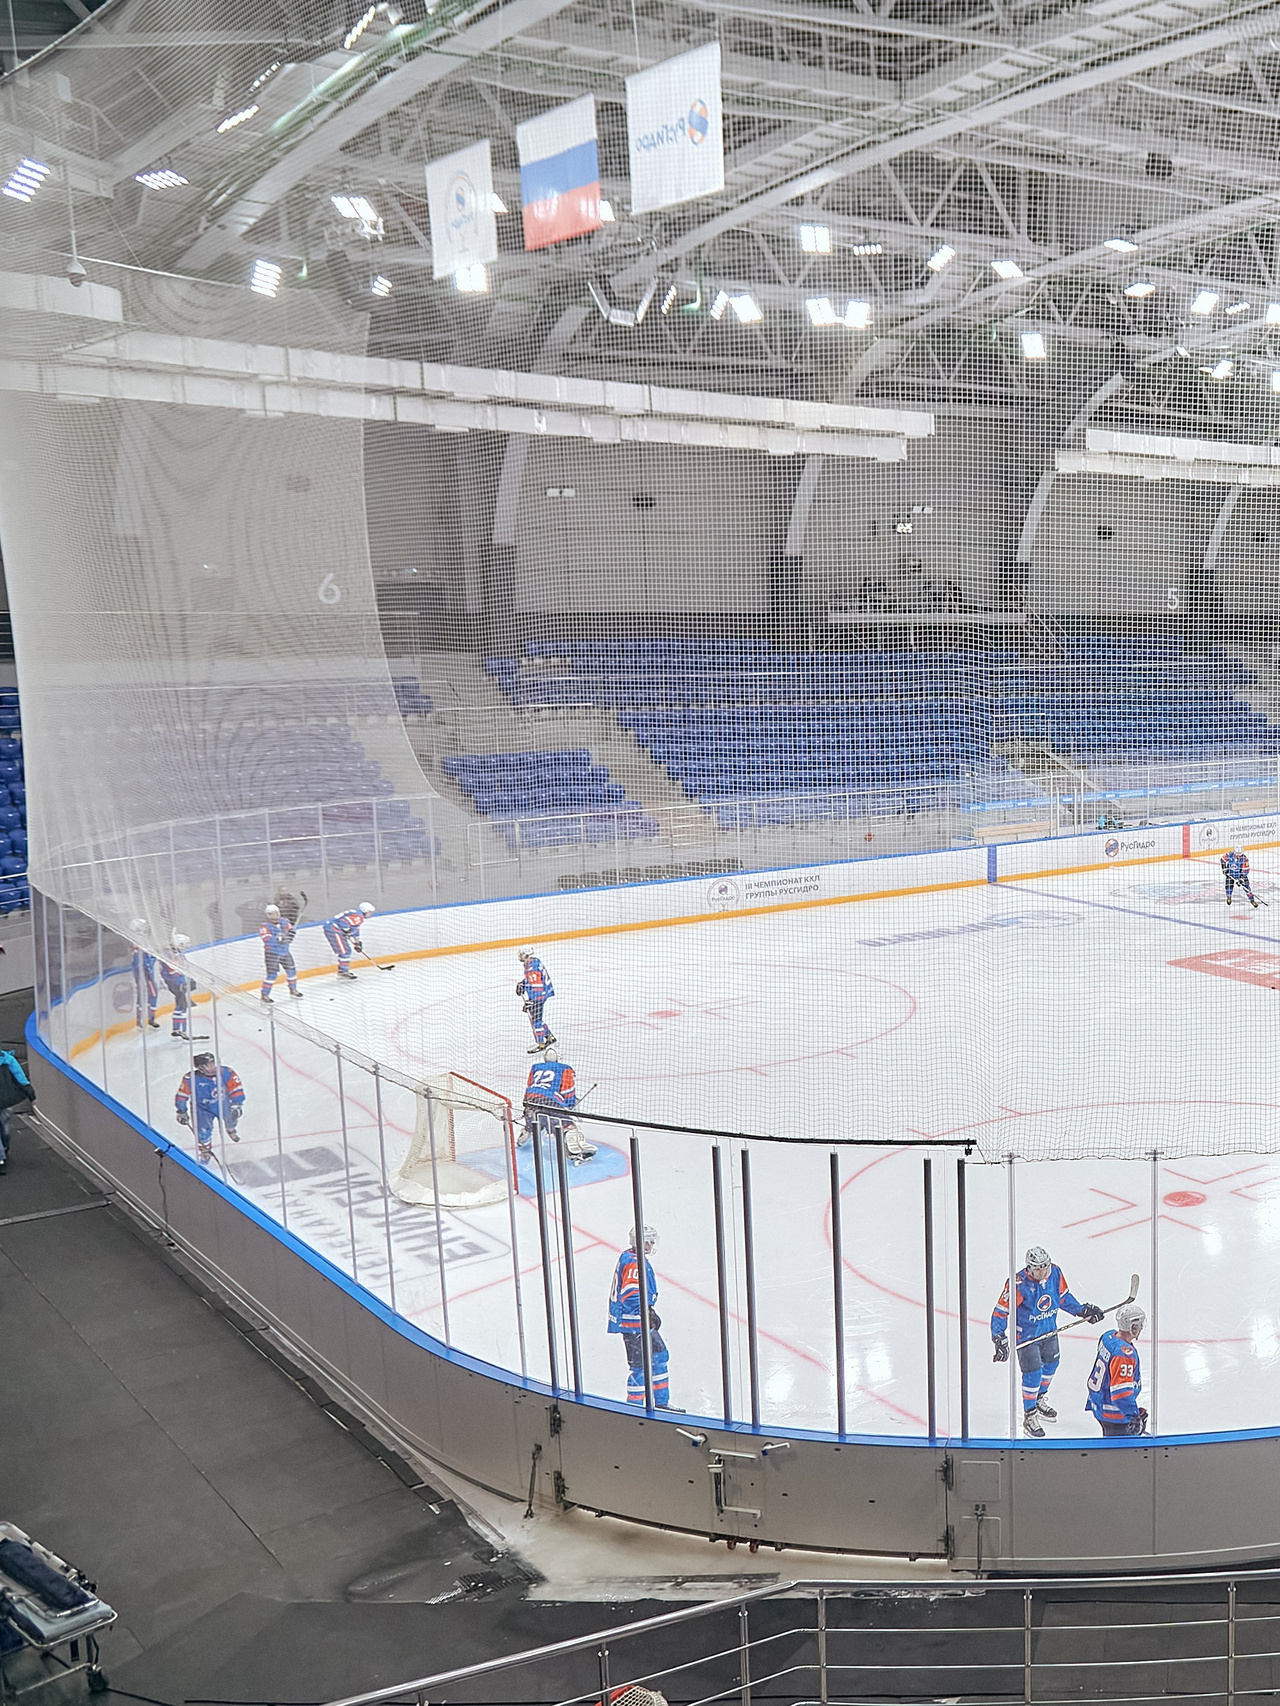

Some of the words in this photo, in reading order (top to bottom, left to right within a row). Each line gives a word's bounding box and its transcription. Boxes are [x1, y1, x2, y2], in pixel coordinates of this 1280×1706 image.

[318, 572, 342, 605] 6
[1120, 840, 1156, 853] РусГидро
[754, 876, 801, 889] ЧЕМПИОНАТ
[802, 874, 820, 884] КХЛ
[745, 889, 777, 900] ГРУППЫ
[779, 884, 819, 897] РУСГИДРО
[303, 1172, 489, 1267] ЕНИСЕЙ
[262, 1188, 402, 1279] ТЕЛЕКАНАЛ
[1120, 1364, 1134, 1378] 33
